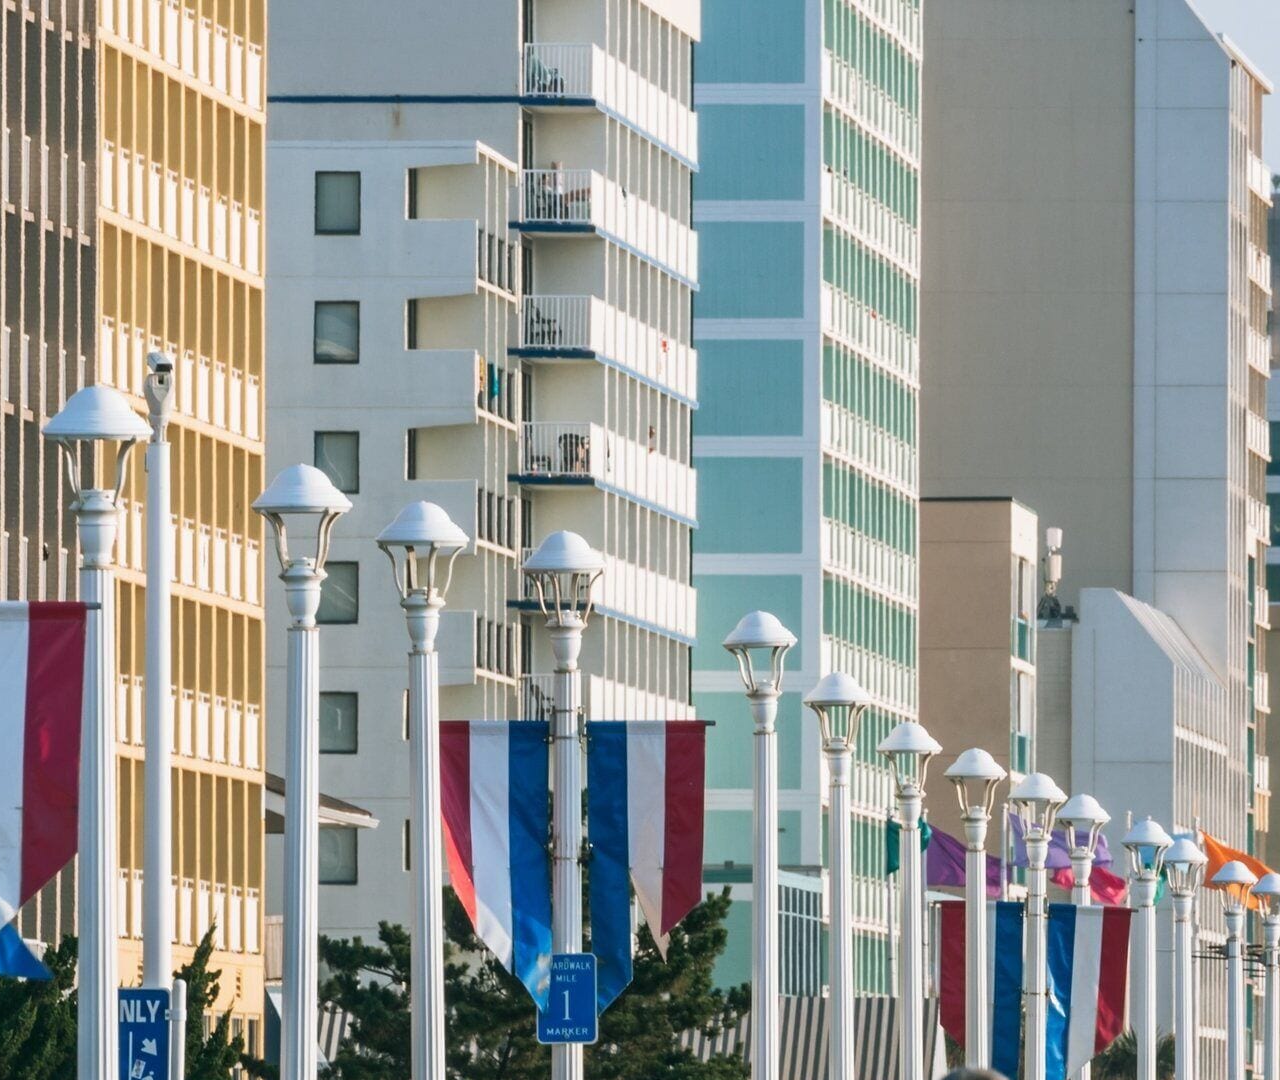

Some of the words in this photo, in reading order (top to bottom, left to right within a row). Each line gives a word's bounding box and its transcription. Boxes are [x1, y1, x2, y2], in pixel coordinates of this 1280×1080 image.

[553, 961, 591, 970] ARDWALK
[556, 974, 577, 983] MILE
[562, 990, 572, 1020] 1
[119, 999, 160, 1023] NLY
[546, 1027, 588, 1036] MARKER
